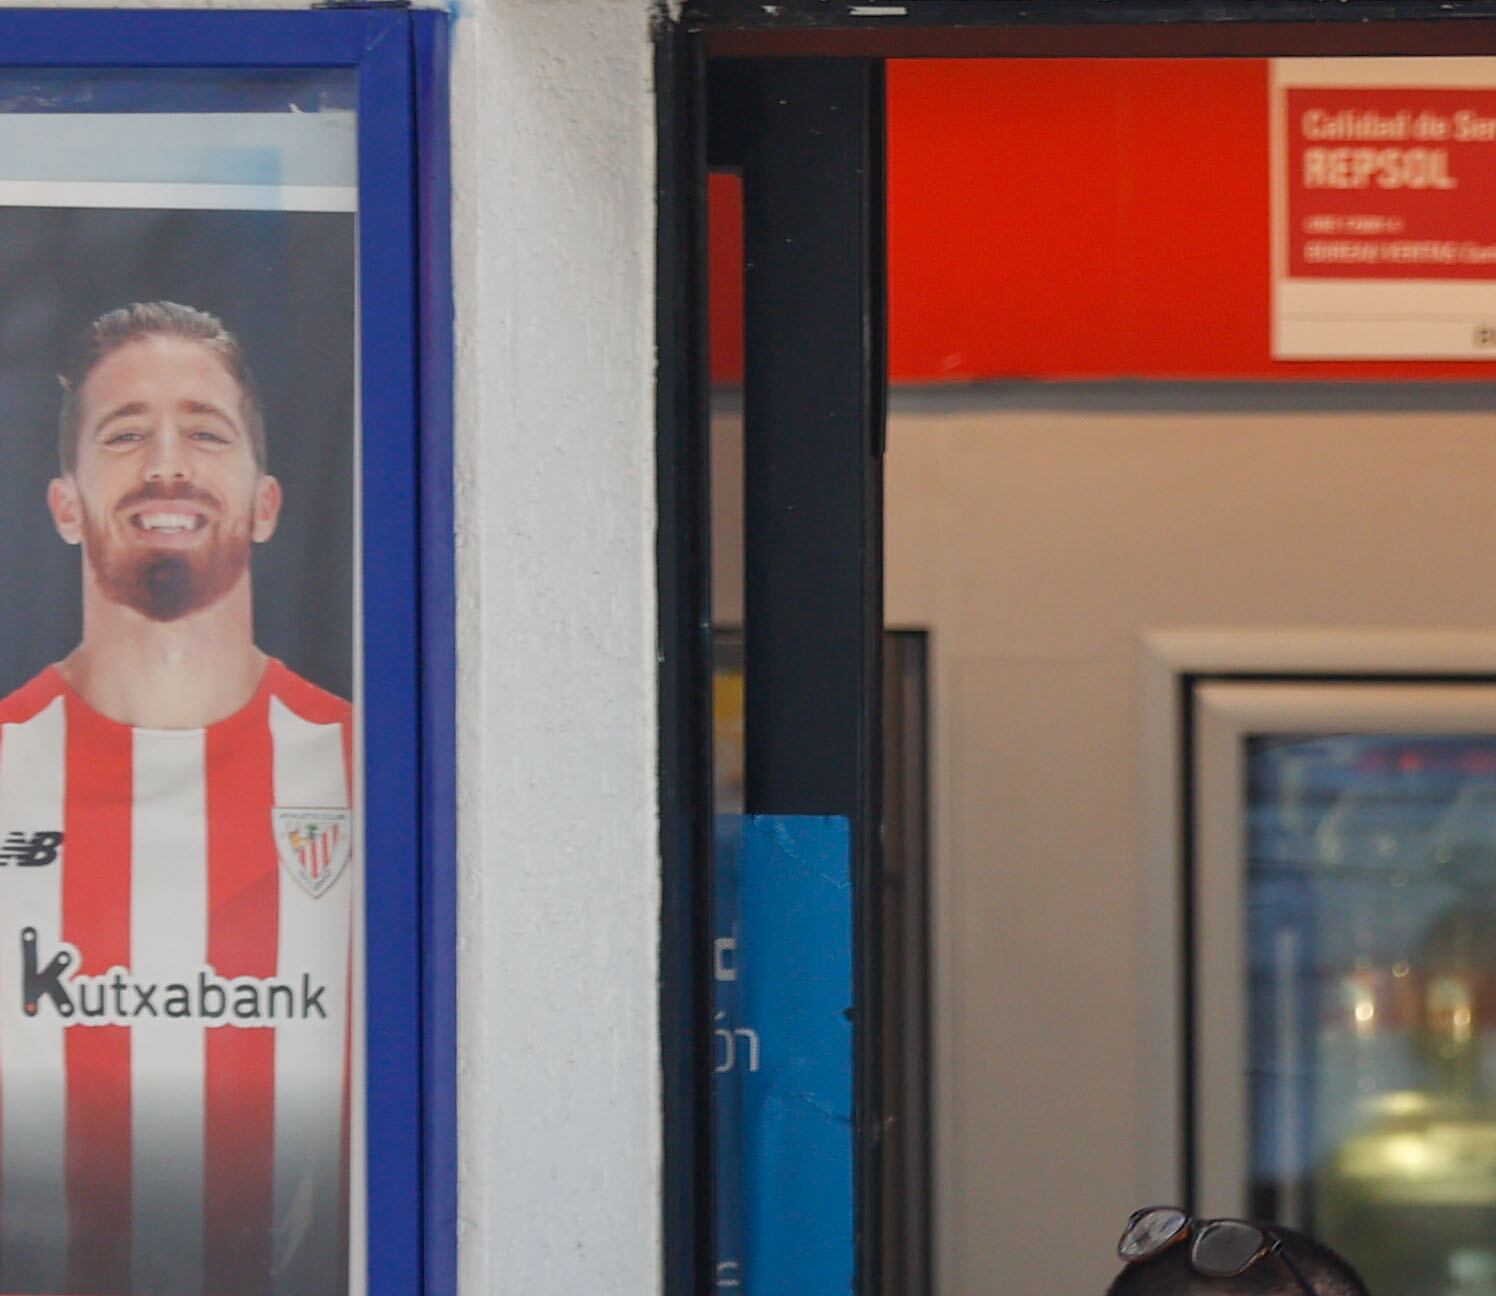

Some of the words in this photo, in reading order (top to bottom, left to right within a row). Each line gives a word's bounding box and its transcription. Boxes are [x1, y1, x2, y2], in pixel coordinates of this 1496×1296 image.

[1302, 108, 1410, 141] Calidad
[1413, 108, 1449, 141] de
[1303, 147, 1458, 189] REPSOL
[20, 927, 328, 1019] Kutxabank
